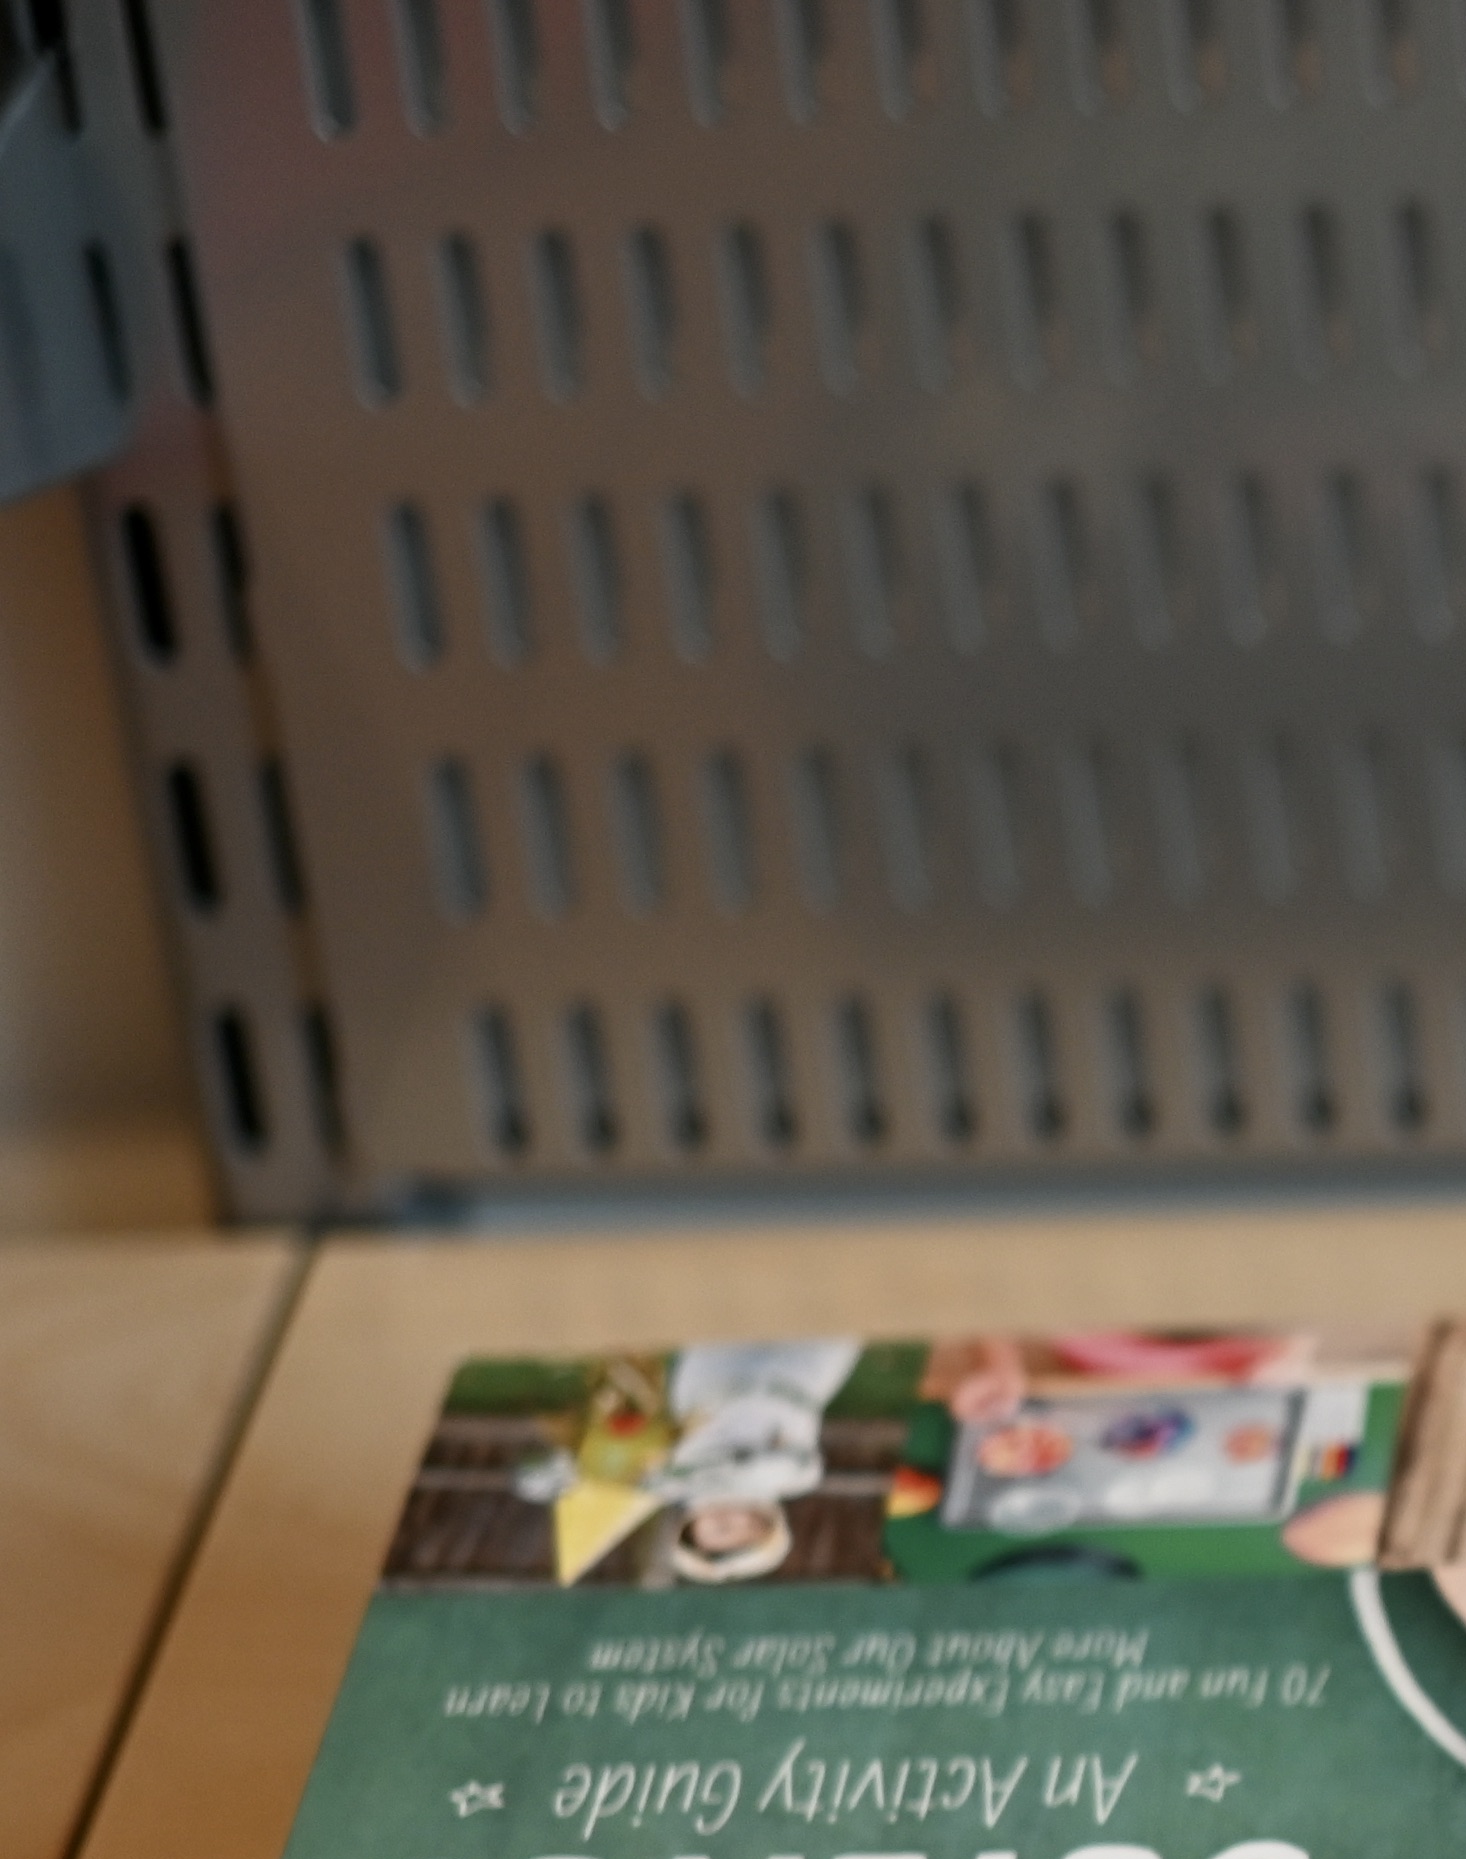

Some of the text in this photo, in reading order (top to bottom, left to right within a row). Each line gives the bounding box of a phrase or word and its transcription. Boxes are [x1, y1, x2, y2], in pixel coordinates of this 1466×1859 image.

[588, 1625, 1150, 1678] More About Our Solar System
[443, 1660, 1332, 1725] 70 Fun and Easy Experiments for Kids to Learn
[553, 1735, 1139, 1842] An Activity Guide
